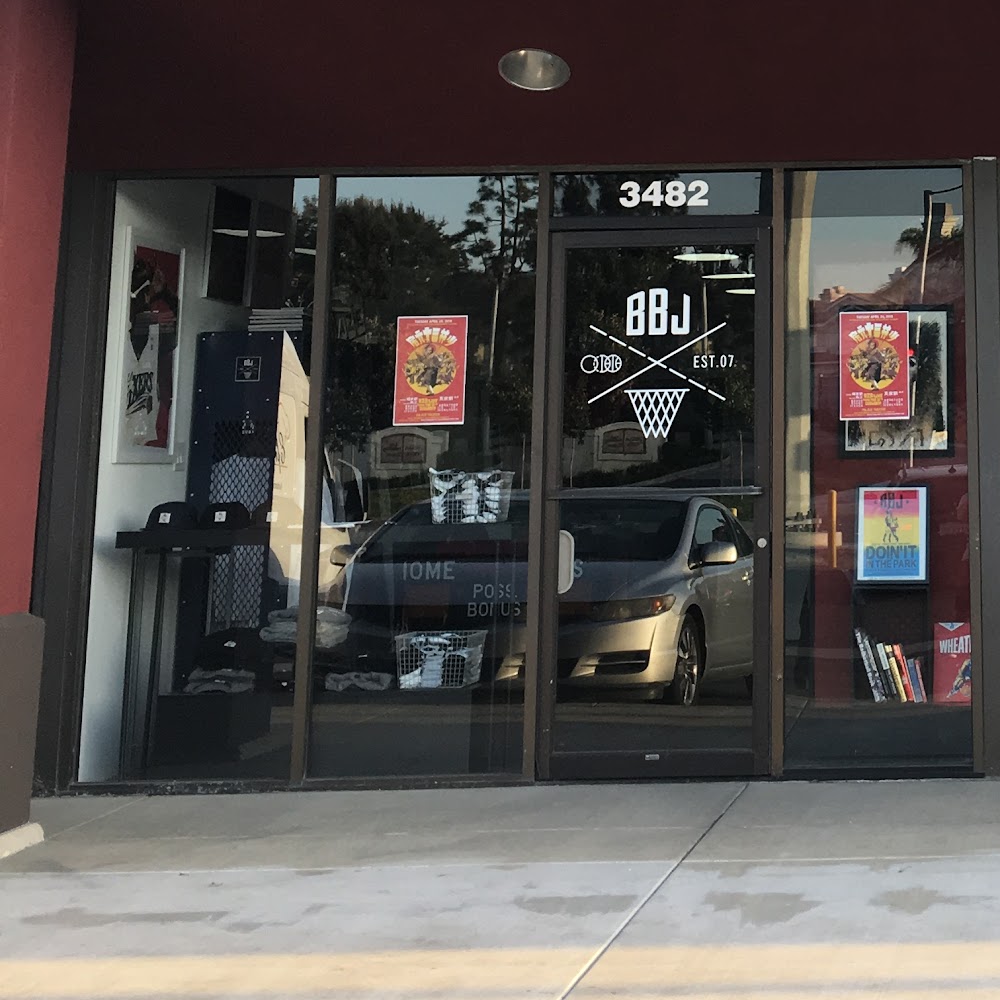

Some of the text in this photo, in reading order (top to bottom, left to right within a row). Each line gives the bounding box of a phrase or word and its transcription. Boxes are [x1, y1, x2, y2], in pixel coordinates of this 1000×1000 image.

[619, 180, 709, 208] 3482
[626, 288, 691, 336] BBJ
[875, 560, 891, 569] THE
[893, 559, 917, 569] PARK
